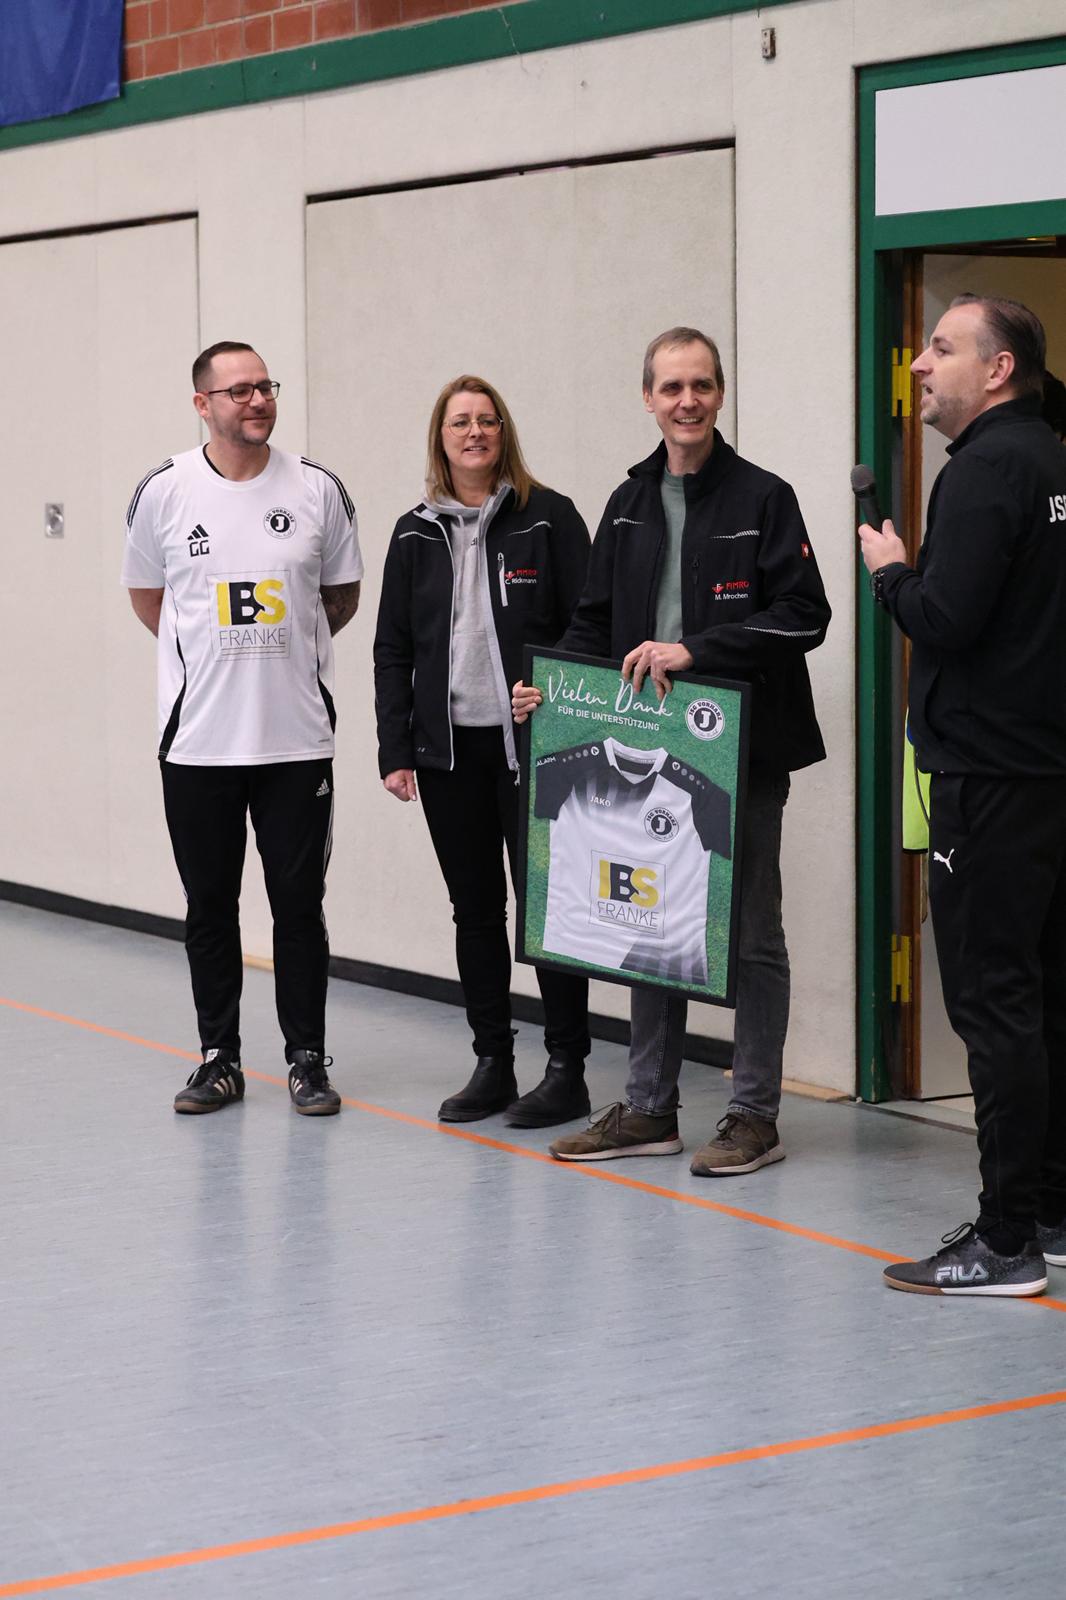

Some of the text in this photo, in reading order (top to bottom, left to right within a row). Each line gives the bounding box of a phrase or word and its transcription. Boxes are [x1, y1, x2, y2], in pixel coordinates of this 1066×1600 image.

[275, 516, 285, 531] J
[189, 540, 210, 557] GG
[216, 579, 286, 627] IBS
[219, 628, 287, 646] FRANKE
[549, 669, 673, 717] Vielen Dank
[558, 706, 660, 732] FÜR DIE UNTERSTÜTZUNG
[700, 710, 711, 728] J
[590, 795, 611, 807] JAKO
[656, 816, 666, 832] J
[599, 859, 659, 909] IBS
[597, 901, 660, 928] FRANKE
[936, 1263, 989, 1282] FILA
